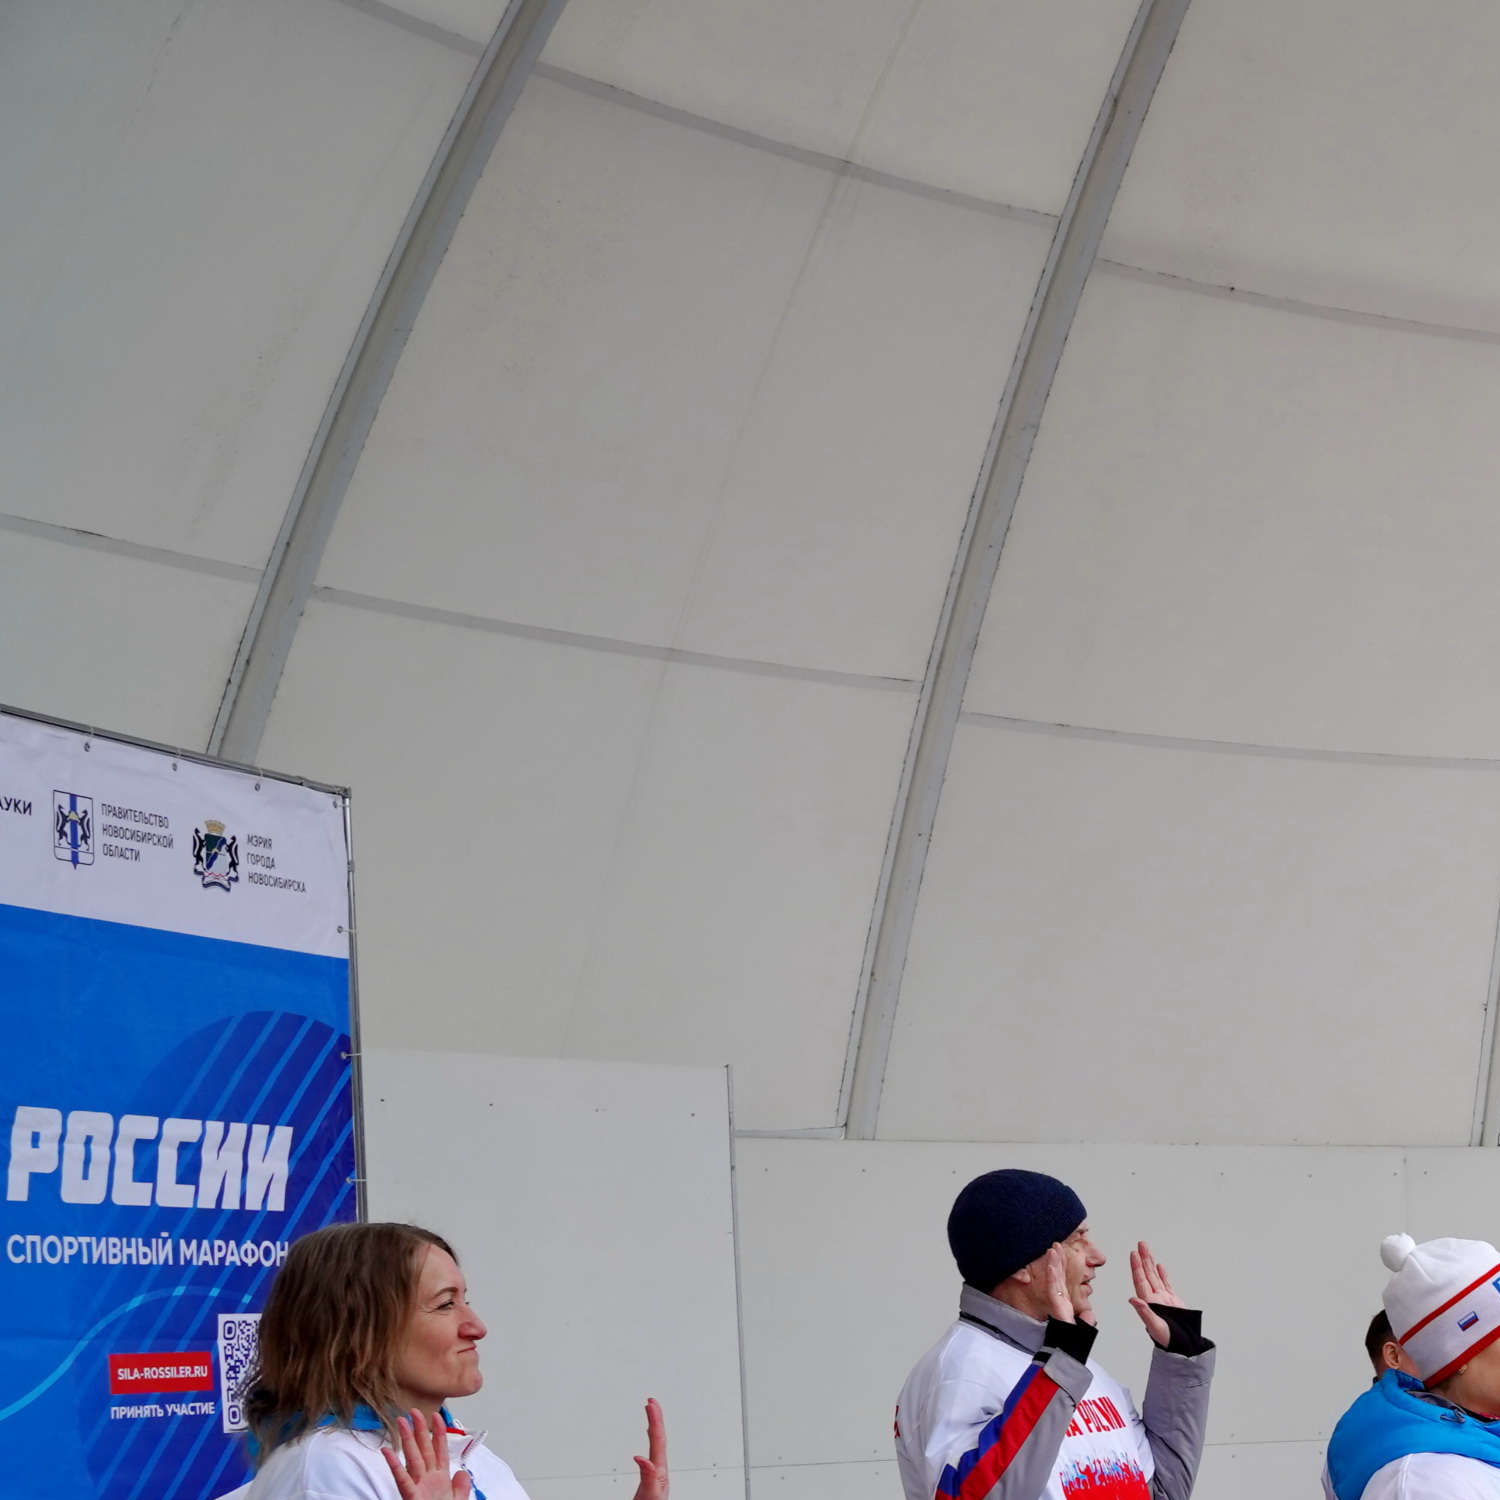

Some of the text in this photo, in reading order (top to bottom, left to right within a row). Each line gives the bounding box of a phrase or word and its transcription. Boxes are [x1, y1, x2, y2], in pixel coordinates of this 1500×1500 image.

[101, 803, 169, 829] ПРАВИТЕЛЬСТВО
[102, 823, 174, 849] НОВОСИБИРСКОЙ
[247, 834, 273, 850] МЭРИЯ
[102, 843, 141, 862] ОБЛАСТИ
[247, 852, 276, 870] ГОРОДА
[248, 871, 307, 893] НОВОСИБИРСКА
[6, 1106, 294, 1212] РОССИИ
[7, 1232, 288, 1267] СПОРТИВНЫЙ МАРАФОН
[117, 1366, 208, 1381] SILA-ROSSII.ER.RU
[110, 1402, 215, 1420] ПРИНЯТЬ УЧАСТИЕ
